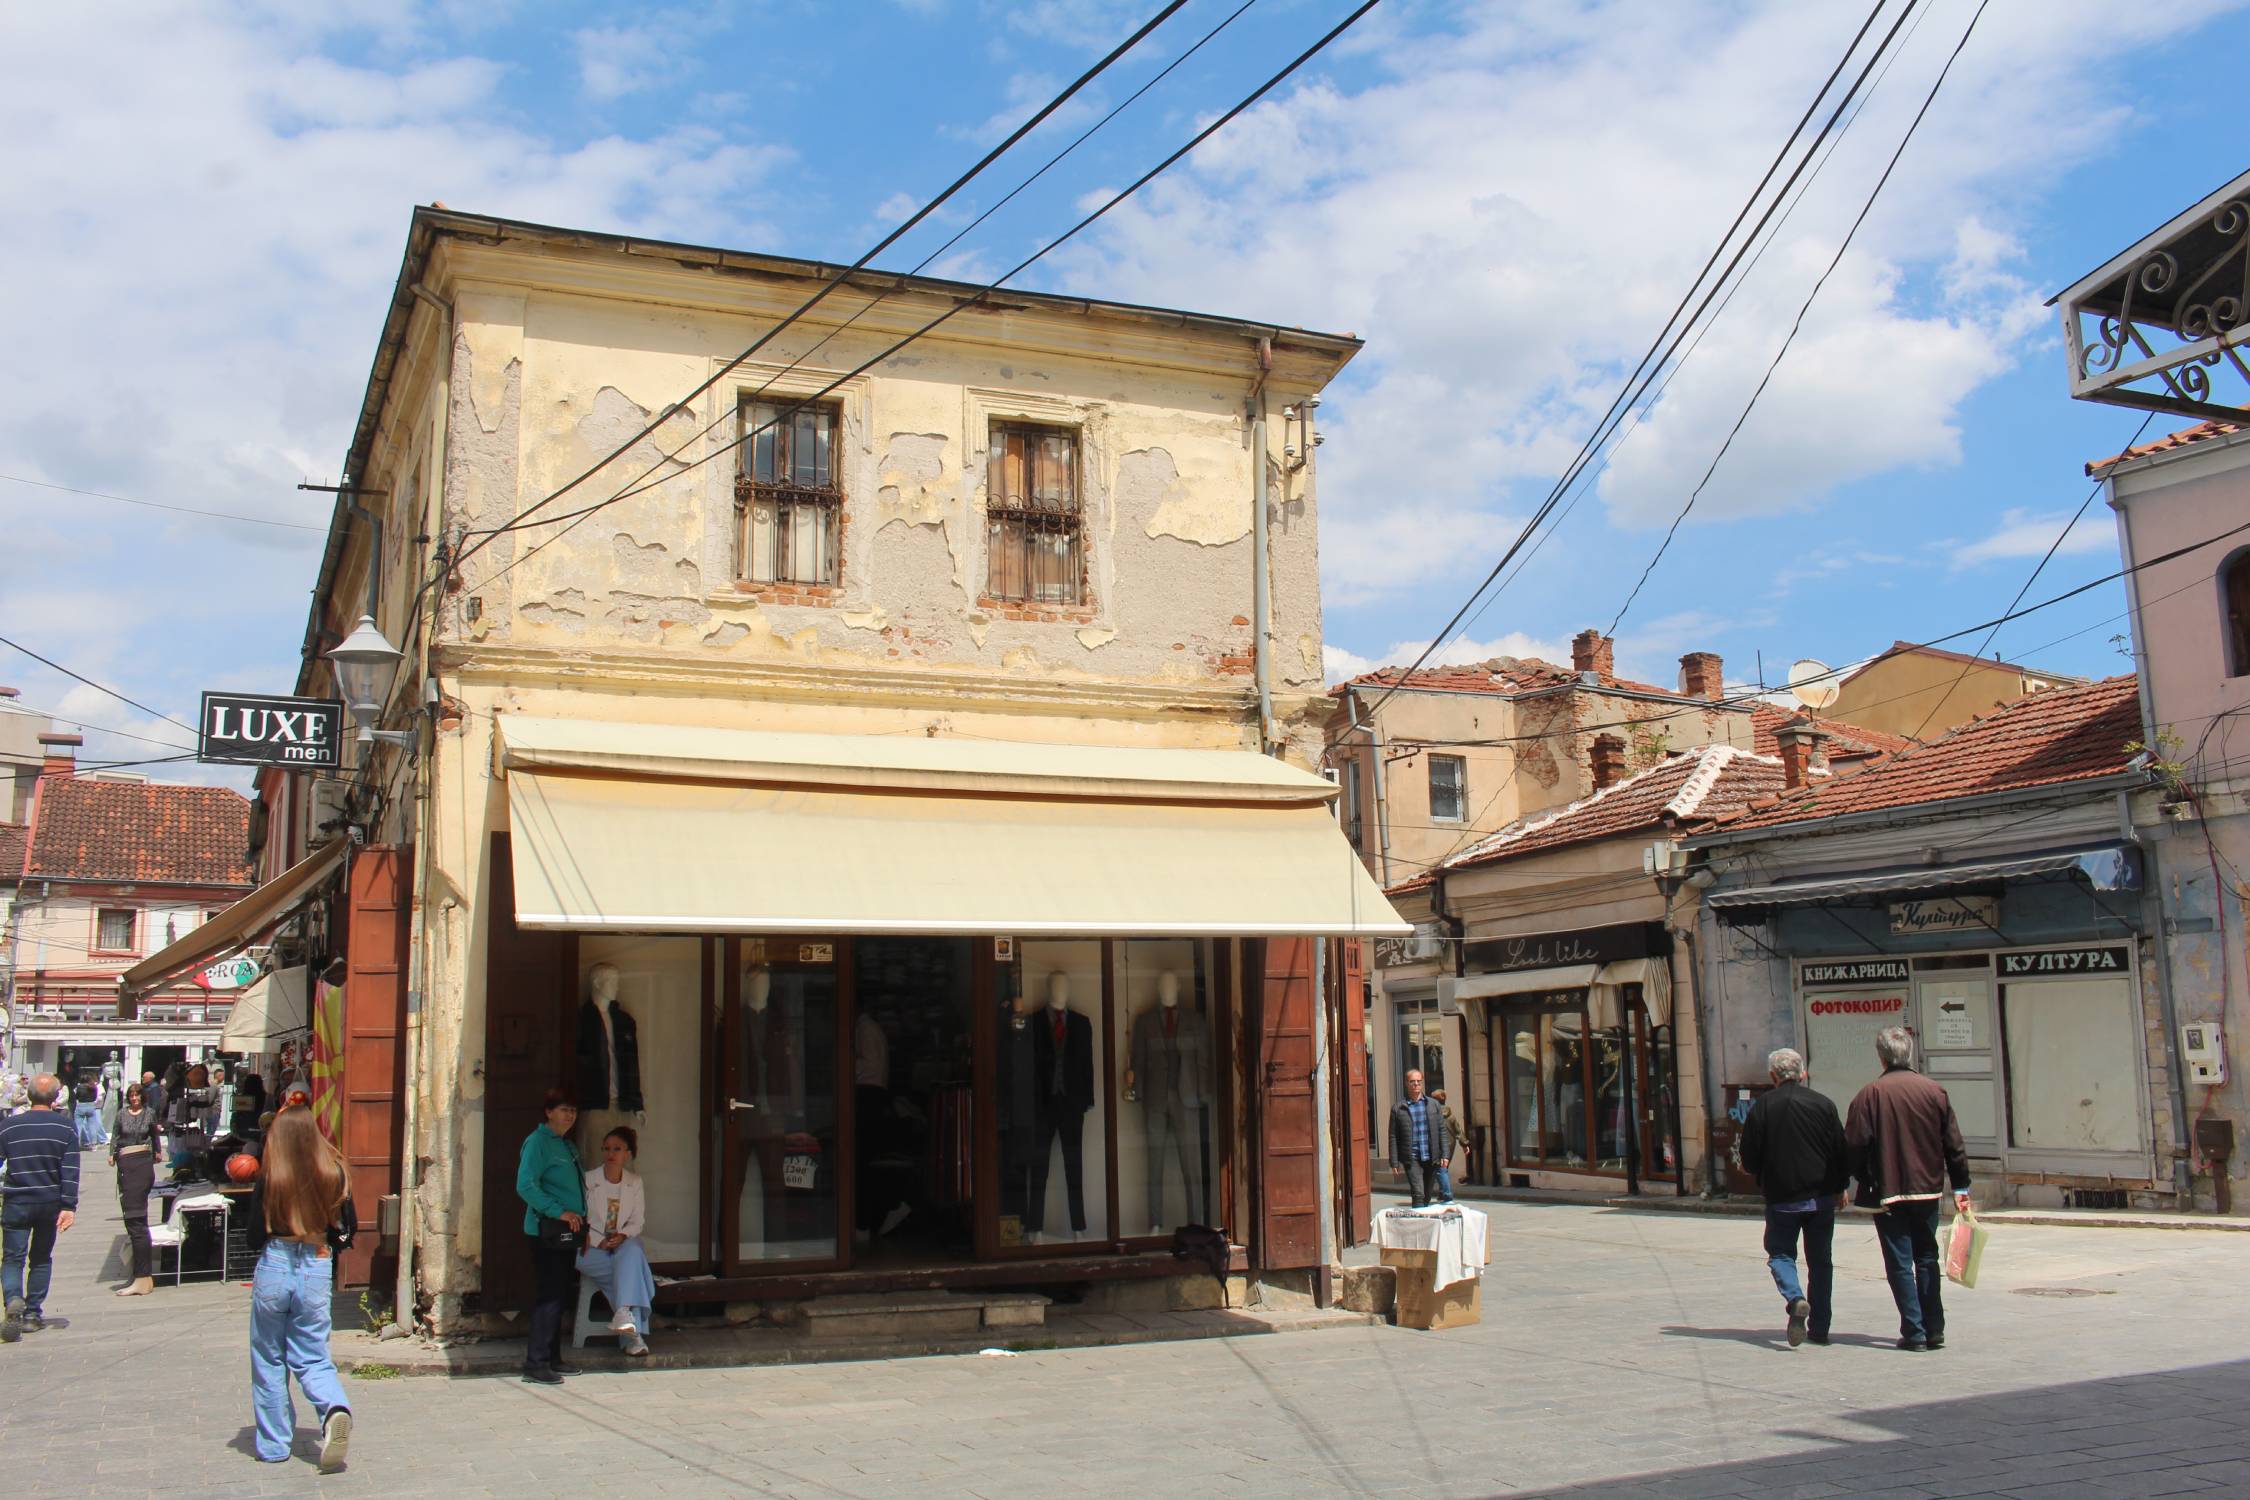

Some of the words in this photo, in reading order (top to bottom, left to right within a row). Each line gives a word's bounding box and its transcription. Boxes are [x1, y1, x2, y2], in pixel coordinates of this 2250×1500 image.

[211, 706, 328, 745] LUXE
[284, 745, 330, 761] men
[1375, 938, 1406, 958] SILV
[2005, 951, 2118, 972] КУЛТУРА
[1804, 963, 1909, 981] КНИЖАРНИЦА
[1810, 998, 1902, 1015] ФОТОКОПИР
